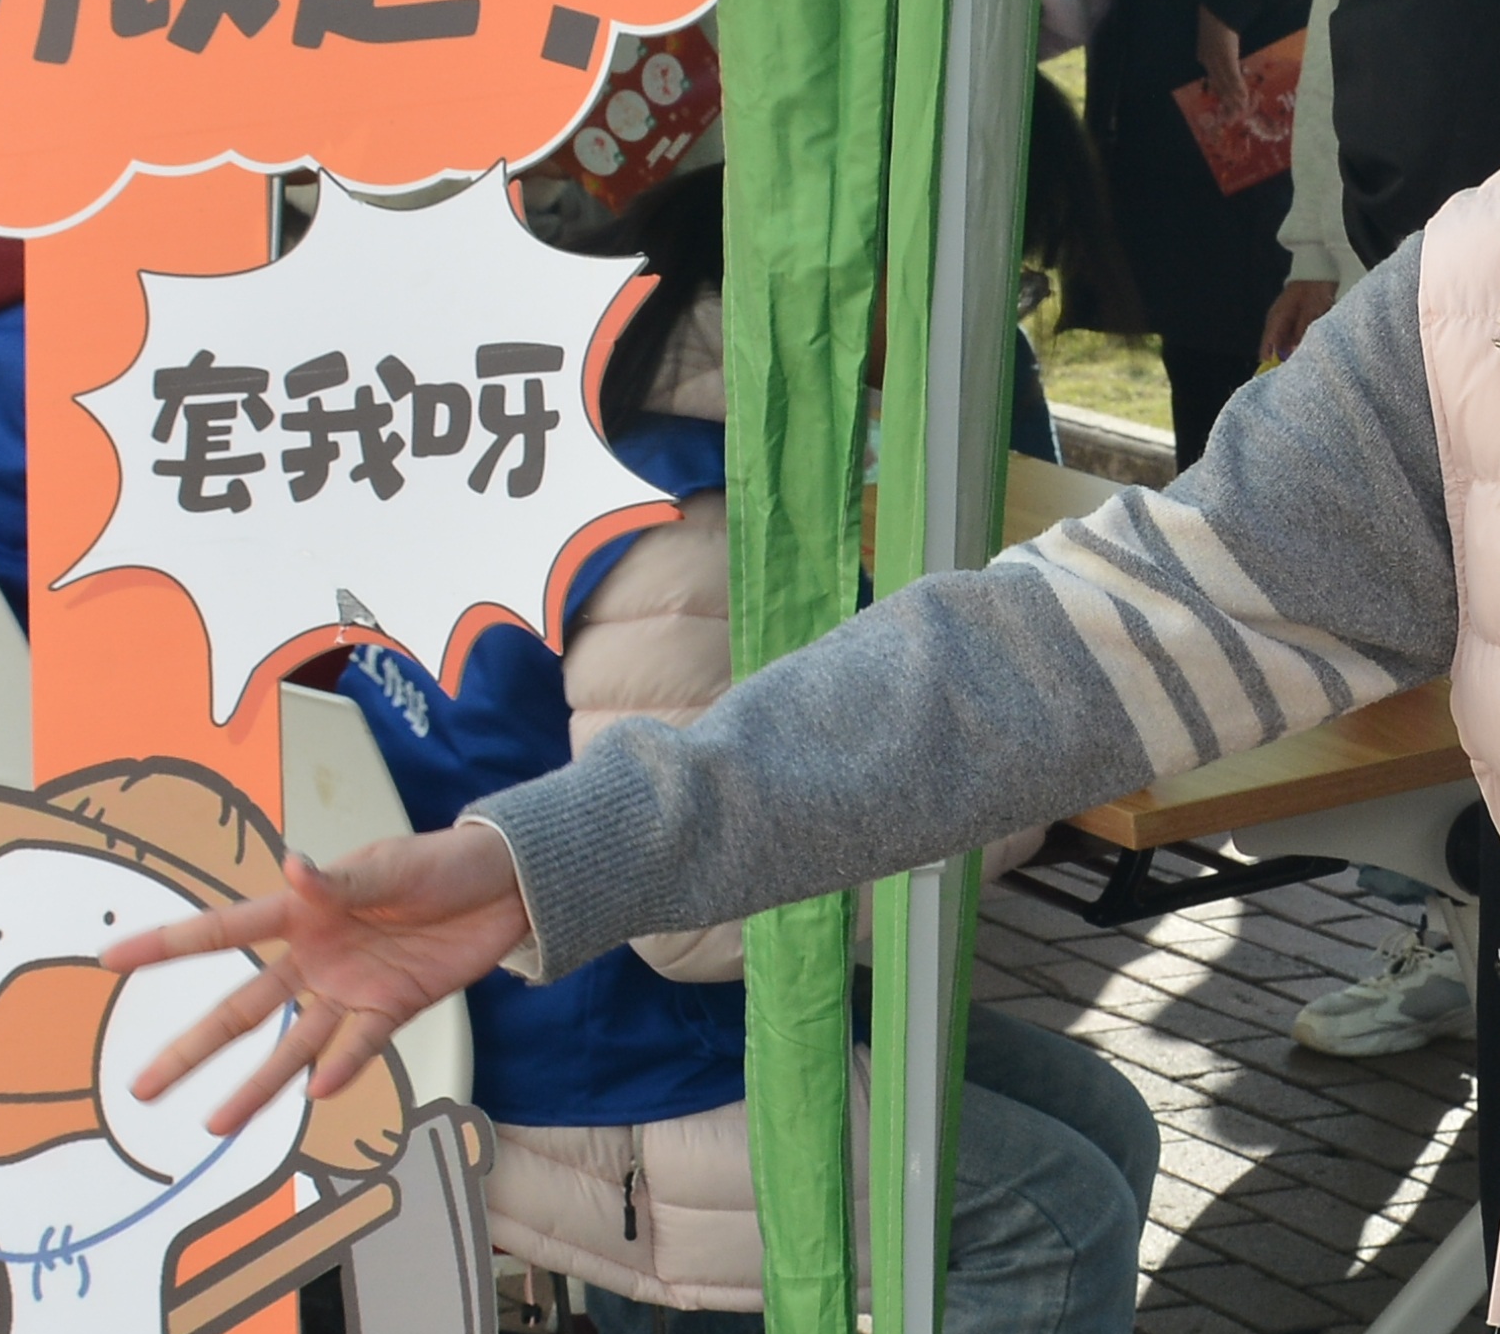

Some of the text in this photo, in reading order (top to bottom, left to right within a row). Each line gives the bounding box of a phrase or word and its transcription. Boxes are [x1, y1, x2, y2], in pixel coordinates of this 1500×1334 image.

[151, 342, 564, 513] 套我呀
[349, 643, 430, 738] 工作站
